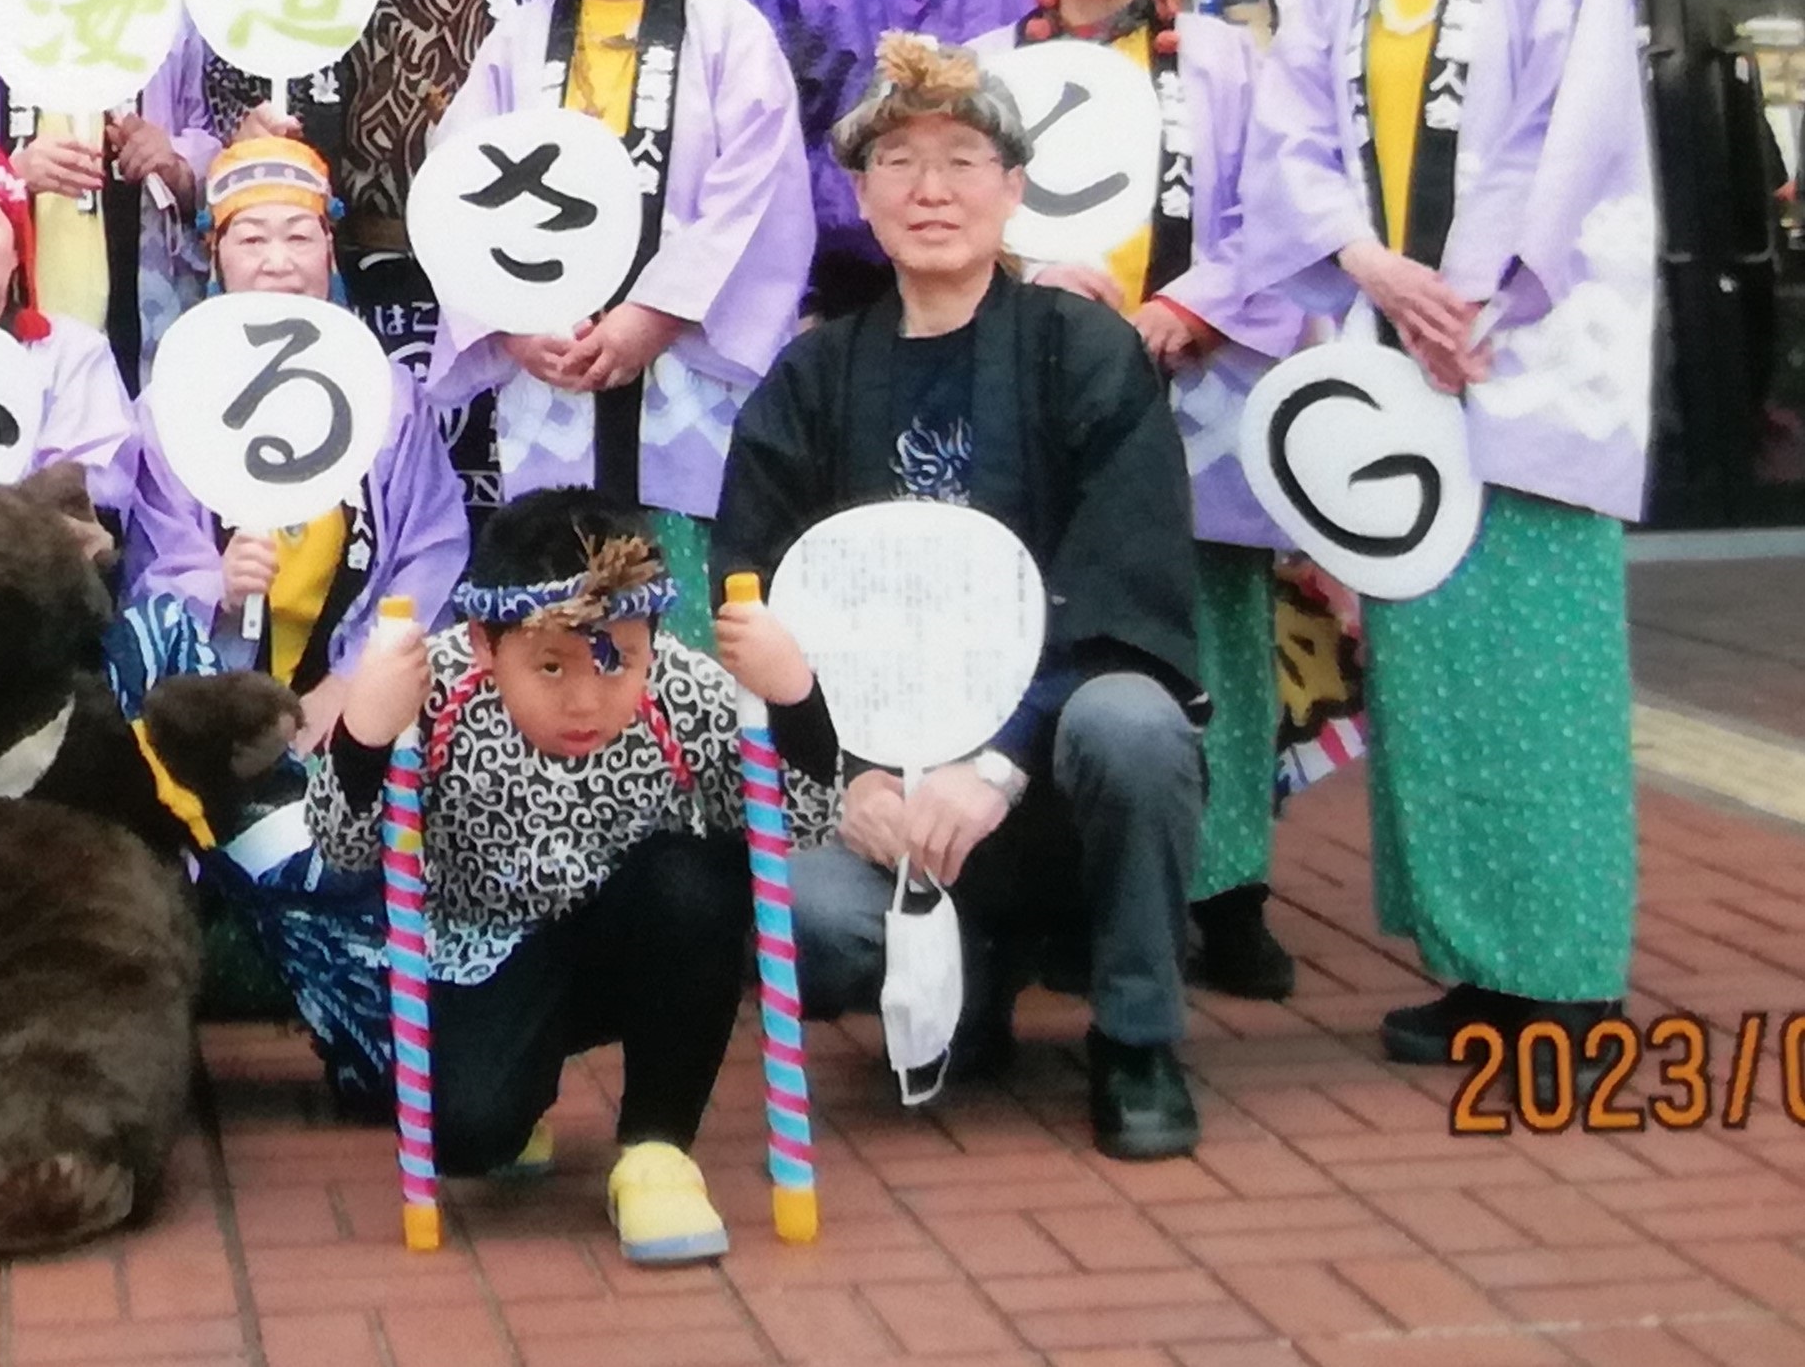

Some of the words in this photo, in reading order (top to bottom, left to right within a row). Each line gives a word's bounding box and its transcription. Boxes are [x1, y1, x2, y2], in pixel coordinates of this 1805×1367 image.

[459, 141, 599, 284] さ
[221, 317, 354, 485] る
[1267, 377, 1443, 559] G
